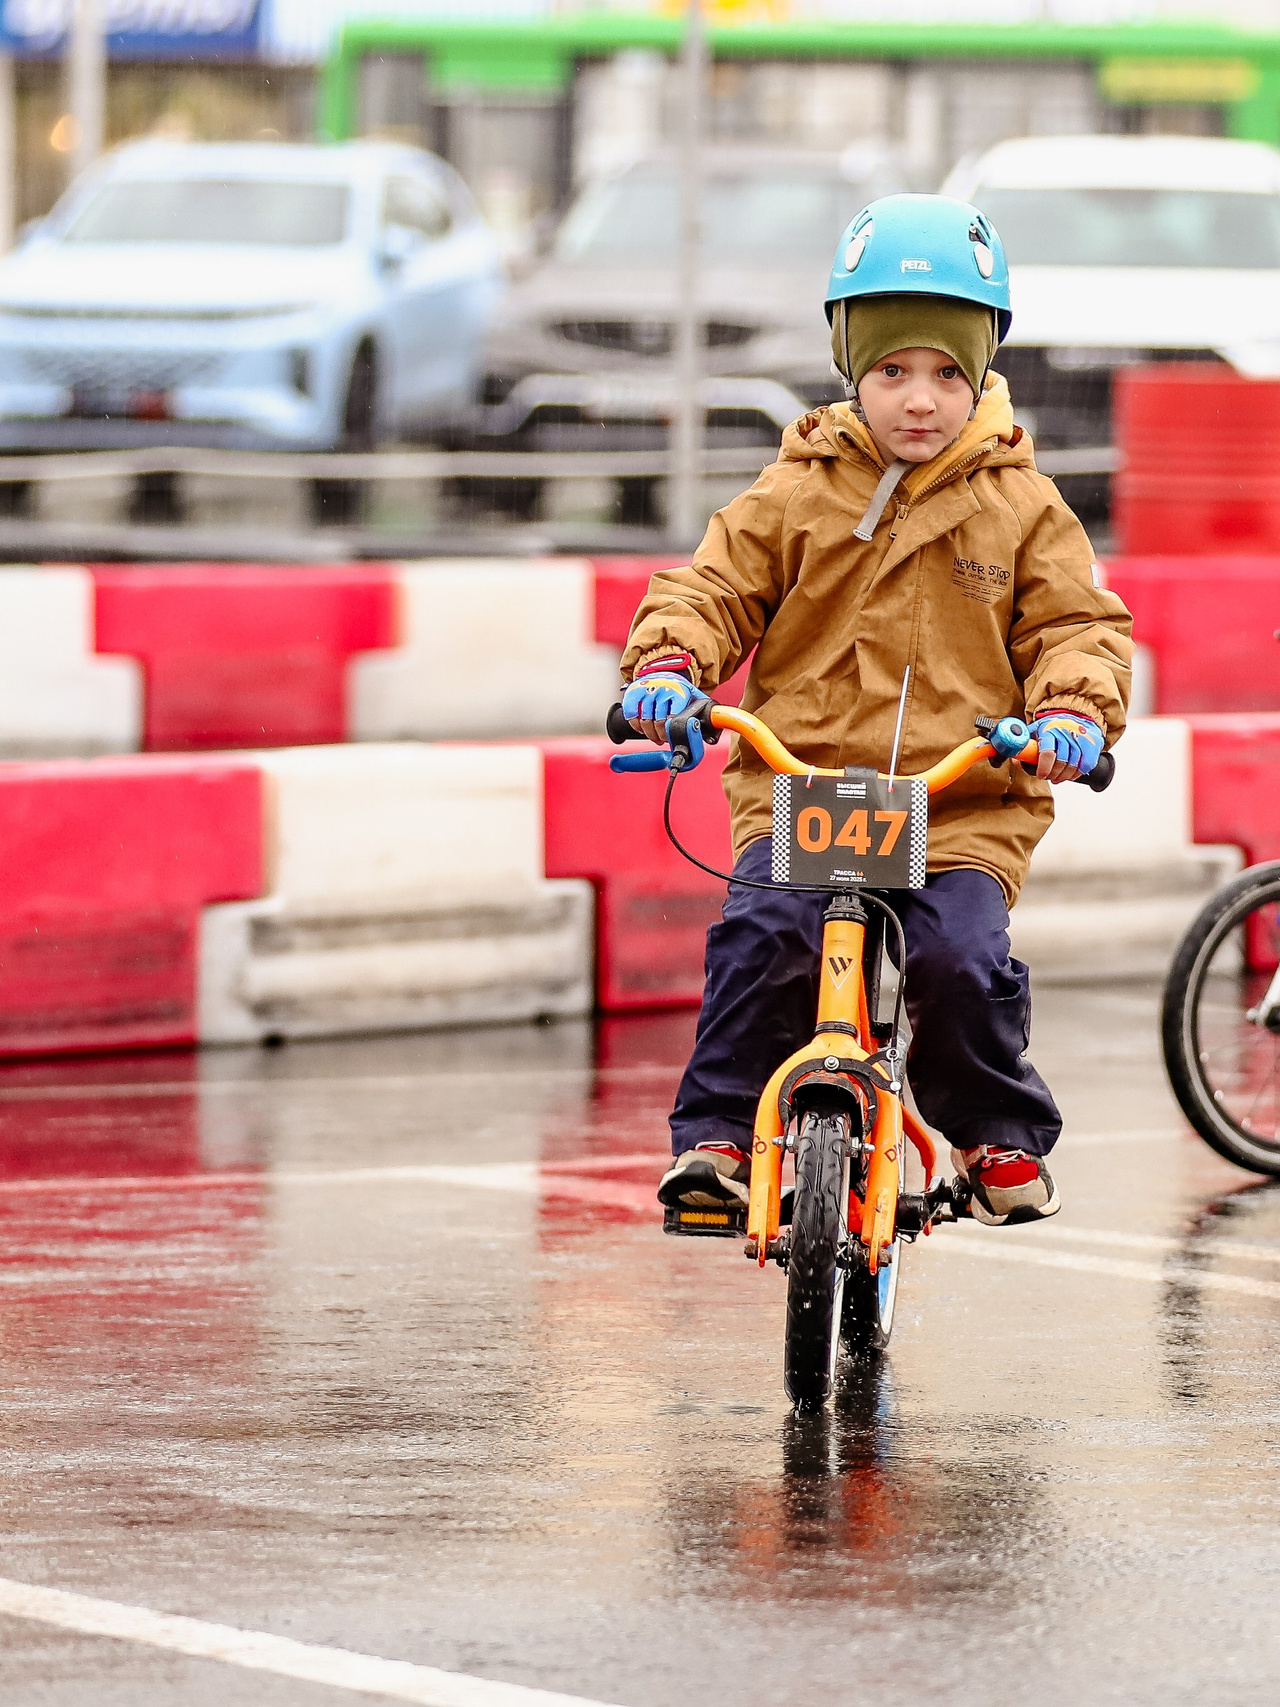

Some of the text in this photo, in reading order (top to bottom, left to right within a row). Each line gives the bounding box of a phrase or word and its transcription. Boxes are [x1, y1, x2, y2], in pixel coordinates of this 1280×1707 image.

[901, 258, 933, 274] PETZL
[954, 557, 1010, 580] NEVER STOP
[797, 806, 908, 856] 047
